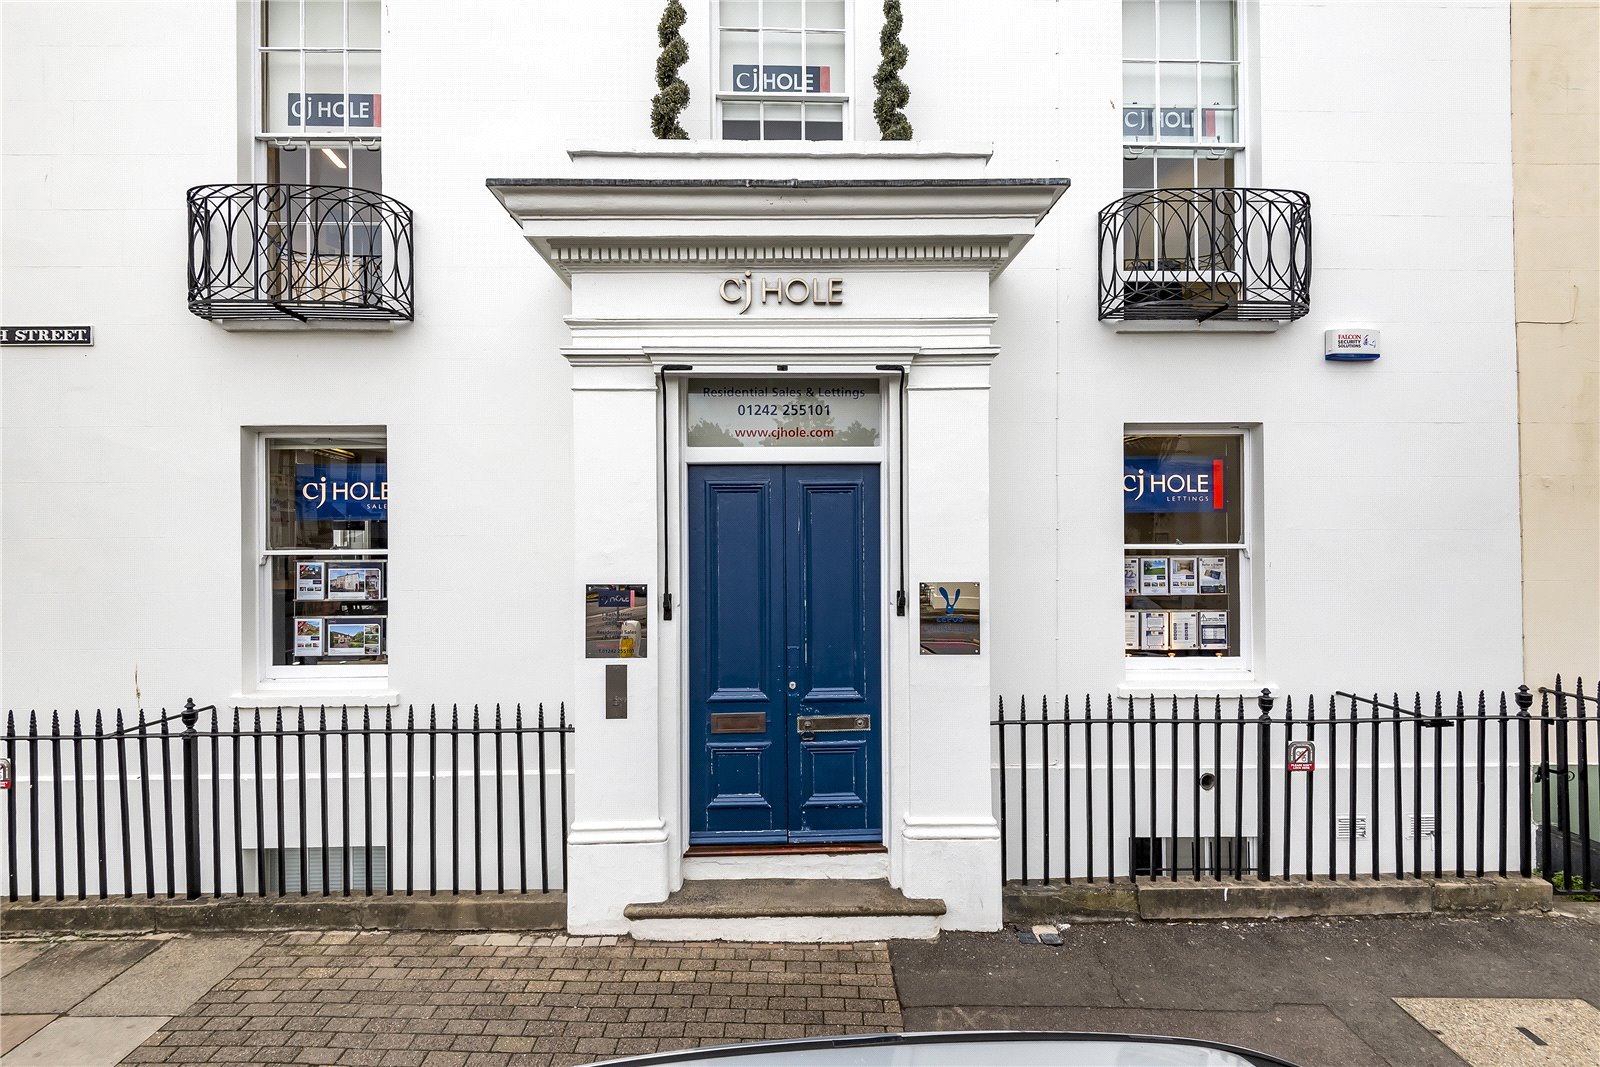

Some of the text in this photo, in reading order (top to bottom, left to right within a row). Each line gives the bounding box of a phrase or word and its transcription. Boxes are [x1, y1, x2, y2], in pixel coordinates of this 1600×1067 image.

[763, 73, 814, 91] HOLE
[318, 101, 370, 119] HOLE
[761, 277, 843, 305] HOLE
[703, 387, 866, 400] Residential Sales & Lettings
[737, 404, 831, 416] 01242 255101
[735, 427, 834, 440] www.cjhole.com
[1150, 474, 1209, 493] HOLE
